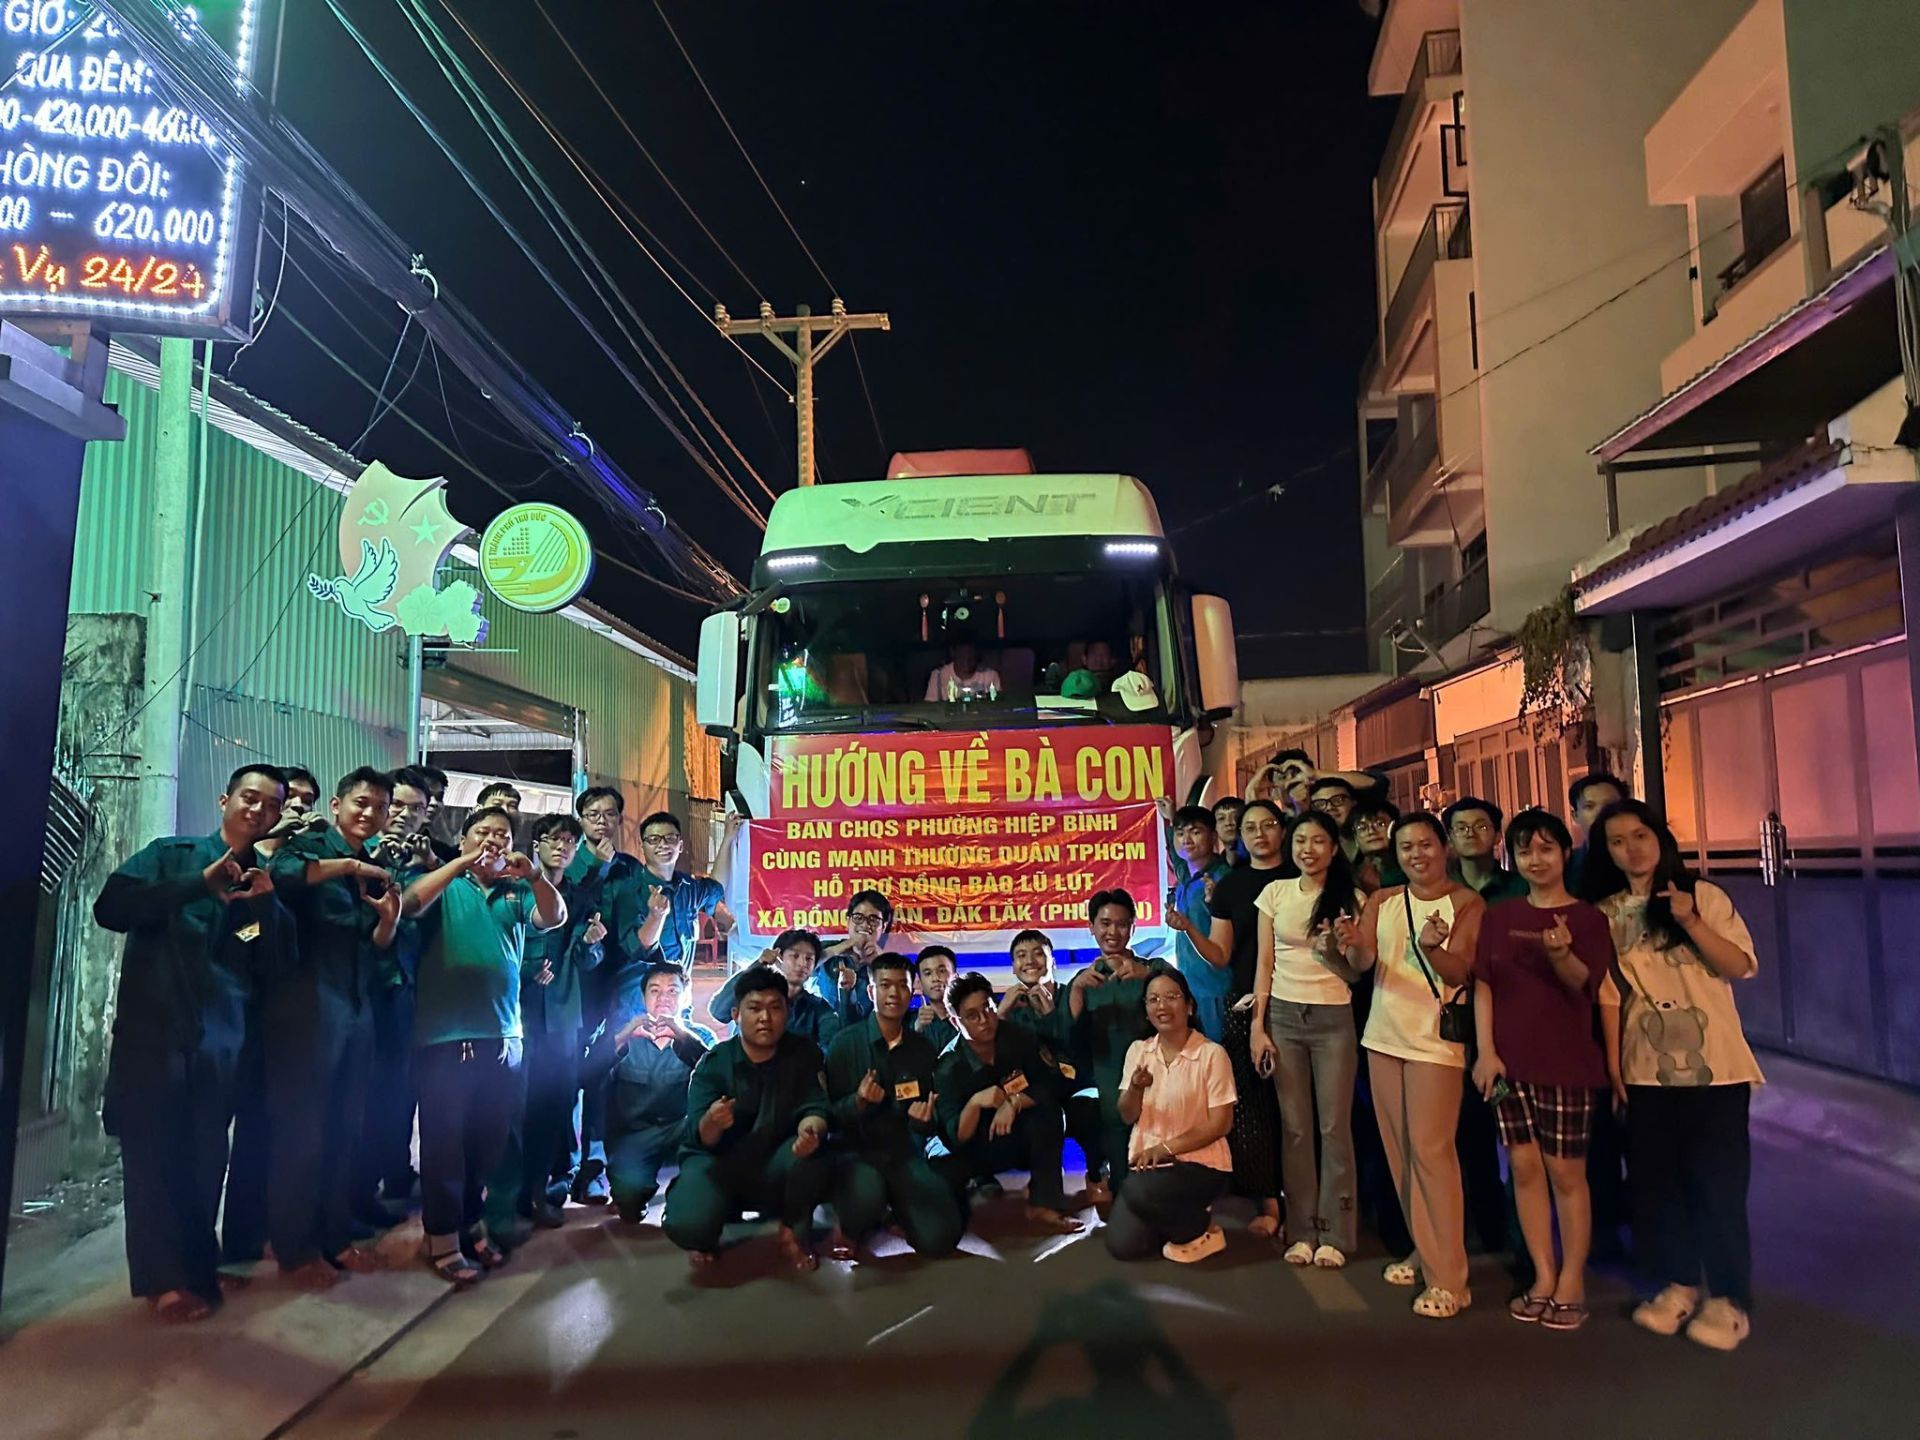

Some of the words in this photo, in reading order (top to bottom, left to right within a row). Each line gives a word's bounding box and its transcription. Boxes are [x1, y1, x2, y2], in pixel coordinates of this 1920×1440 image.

[16, 50, 73, 90] QUA
[79, 48, 153, 95] ĐÊM:
[98, 150, 170, 198] ĐÔI:
[93, 201, 214, 245] 620.000
[14, 244, 66, 293] Vụ
[782, 741, 926, 809] HƯỚNG
[939, 731, 991, 805] VỀ
[1005, 736, 1063, 803] BÀ
[1076, 745, 1165, 802] CON
[787, 820, 832, 840] BAN
[839, 819, 899, 840] CHQS
[906, 813, 998, 837] PHƯỜNG
[1005, 812, 1056, 837] HIỆP
[1063, 811, 1117, 833] BÌNH
[762, 848, 821, 870] CÙNG
[828, 849, 895, 871] MẠNH
[901, 843, 991, 867] THƯỜNG
[1066, 842, 1146, 862] TPHCM
[813, 873, 844, 898] HỖ
[900, 871, 961, 896] ĐỒNG
[968, 872, 1014, 894] BÀO
[1021, 871, 1048, 893] LŨ
[1055, 872, 1094, 895] LỤT
[757, 907, 788, 928] XÃ
